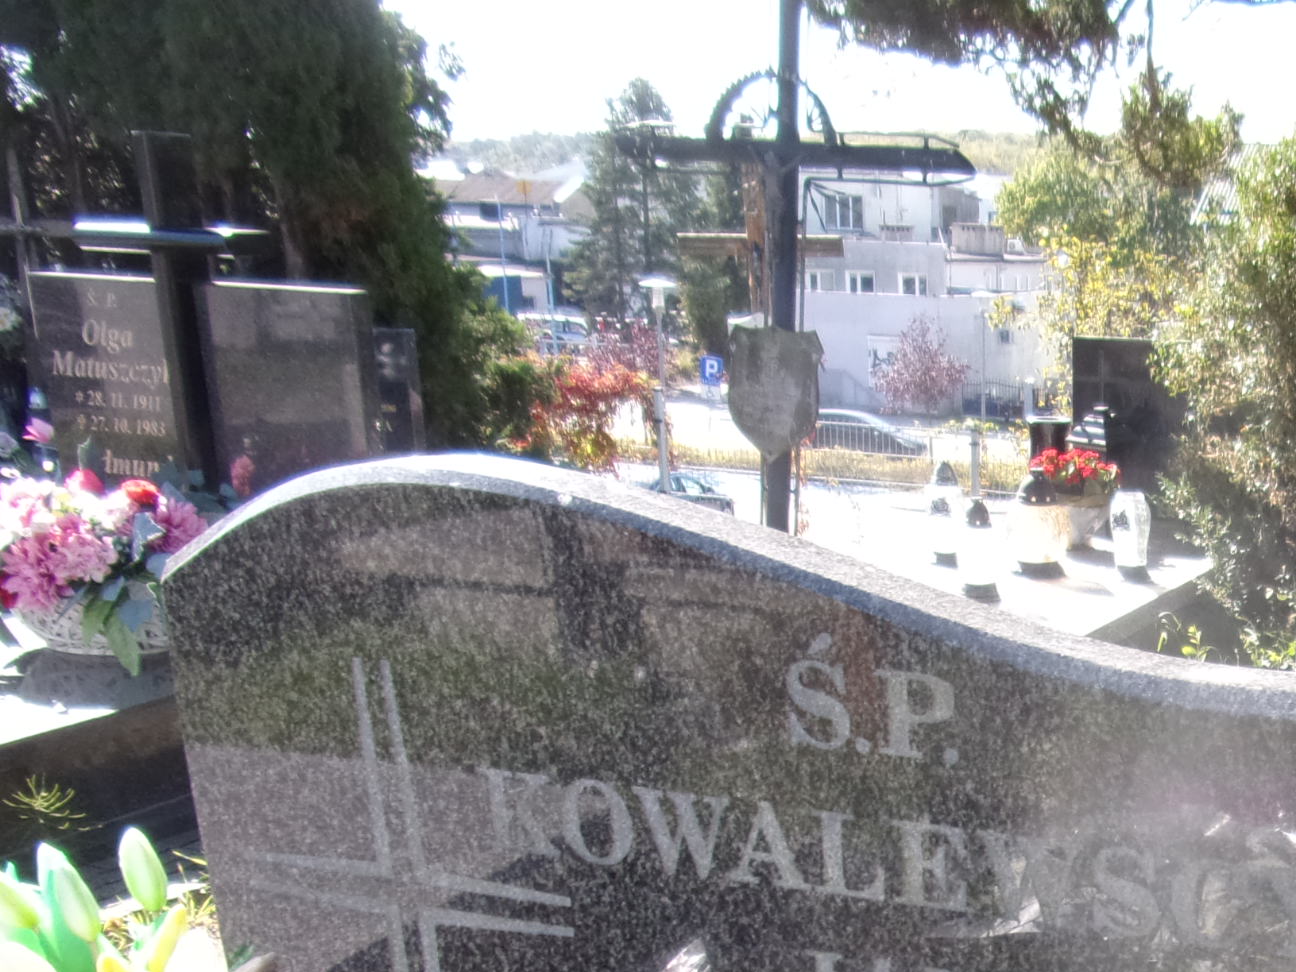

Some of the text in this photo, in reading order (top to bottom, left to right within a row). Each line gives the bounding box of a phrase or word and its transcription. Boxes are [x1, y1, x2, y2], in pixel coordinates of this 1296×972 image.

[82, 320, 134, 355] Olga
[705, 359, 718, 378] P
[786, 632, 960, 767] Ś.P.
